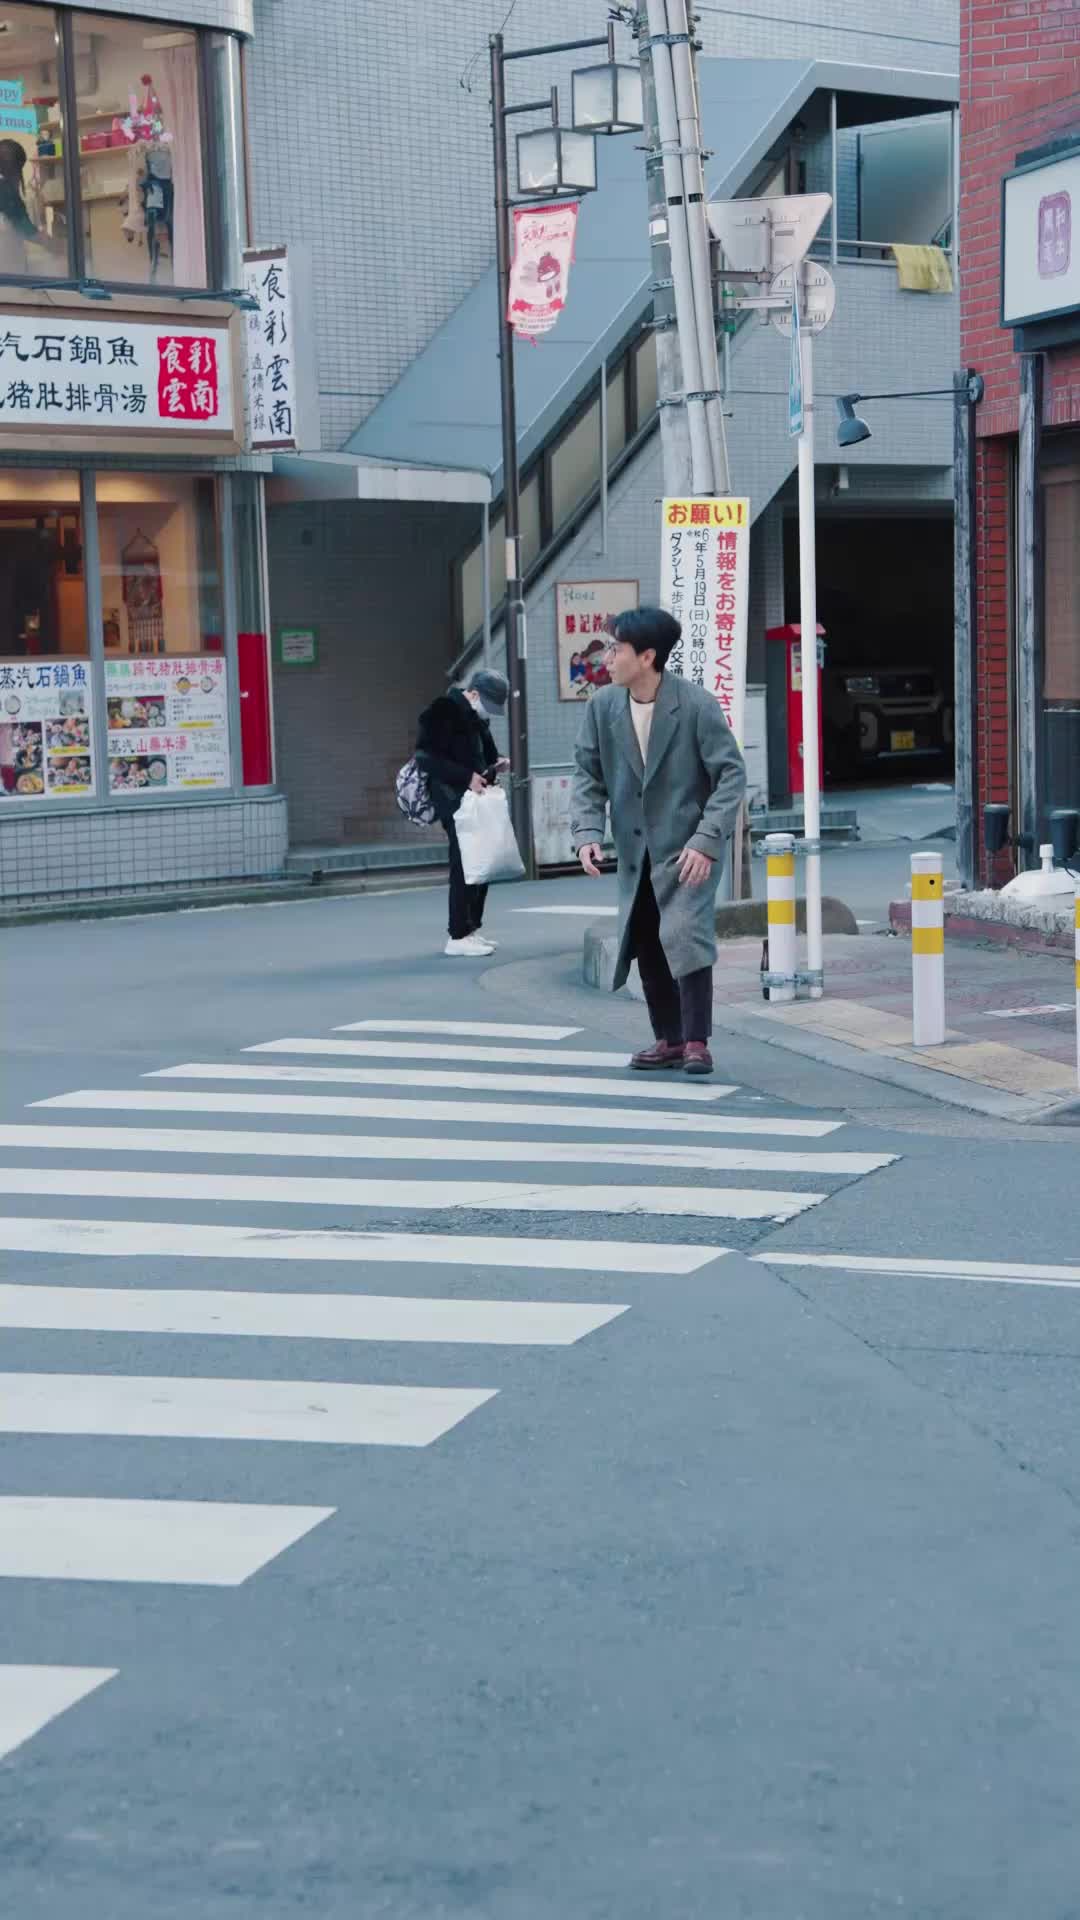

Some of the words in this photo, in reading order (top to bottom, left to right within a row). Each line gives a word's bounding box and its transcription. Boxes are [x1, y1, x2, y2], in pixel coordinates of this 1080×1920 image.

[262, 263, 292, 435] 食彩雲南
[0, 380, 147, 413] 猪肚排骨湯
[668, 503, 743, 526] お願い!
